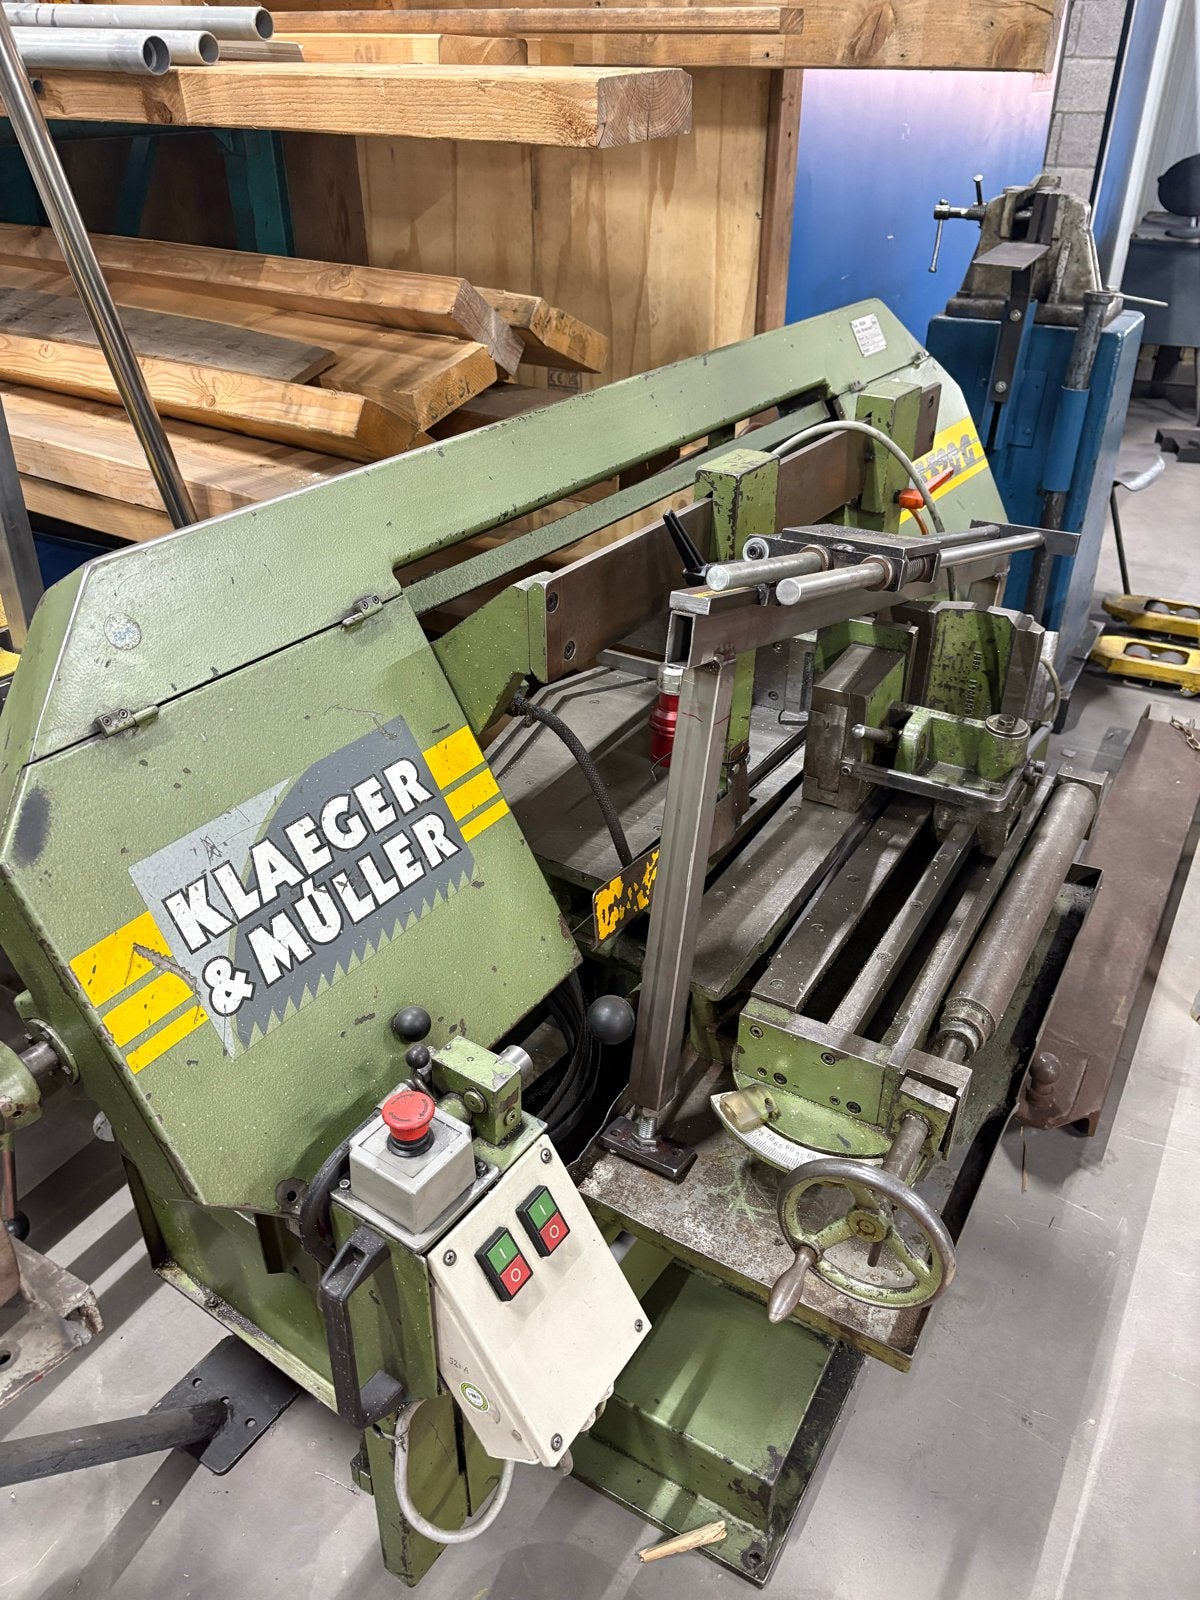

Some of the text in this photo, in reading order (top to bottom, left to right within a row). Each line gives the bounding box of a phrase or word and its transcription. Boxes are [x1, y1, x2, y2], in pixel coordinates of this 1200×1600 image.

[163, 758, 435, 953] KLAEGER
[202, 812, 462, 1016] & MÜLLER
